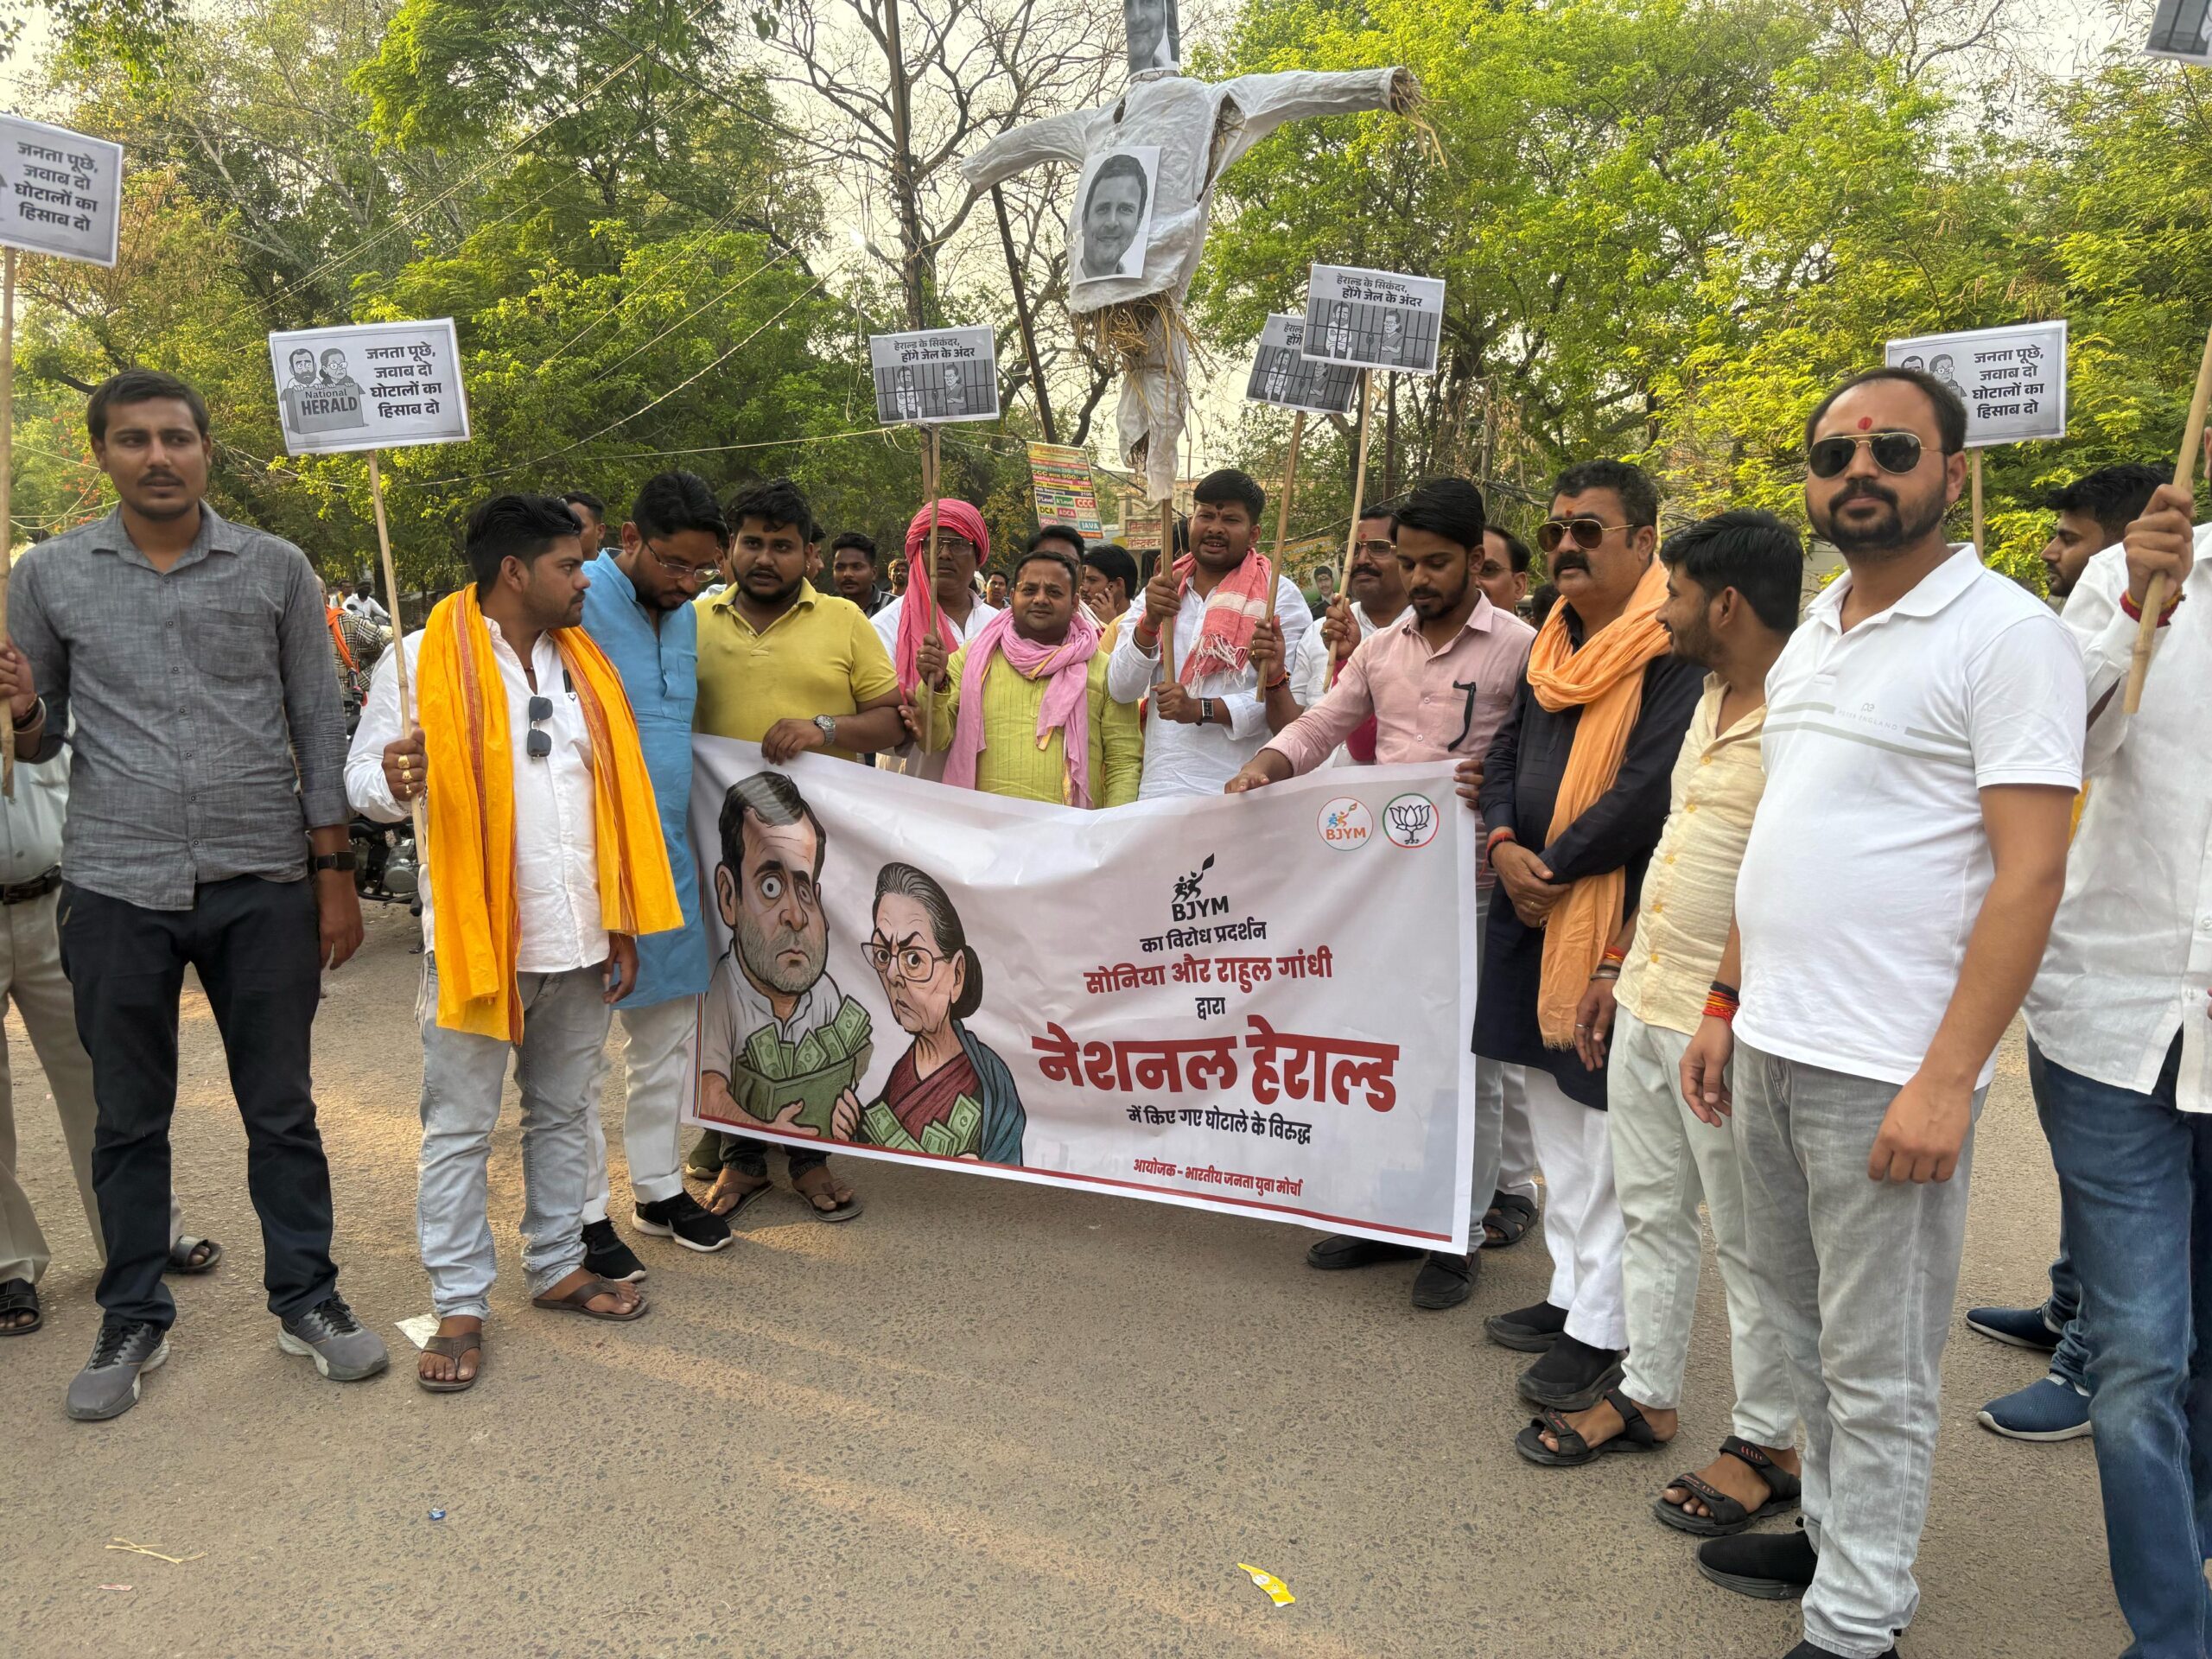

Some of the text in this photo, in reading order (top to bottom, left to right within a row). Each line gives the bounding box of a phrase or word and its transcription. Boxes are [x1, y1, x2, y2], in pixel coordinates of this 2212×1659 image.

[17, 142, 64, 163] जनता
[23, 164, 91, 190] जवाब दो
[14, 181, 99, 212] घोटालों का
[19, 202, 91, 232] हिसाब दो
[1337, 273, 1363, 287] हेराल्ड
[1363, 276, 1374, 288] के
[1342, 285, 1423, 308] होंगे जेल के अंदर
[365, 346, 405, 359] जनता
[893, 340, 918, 351] हेराल्ड
[919, 339, 928, 347] के
[901, 346, 975, 362] होंगे जेल के अंदर
[1974, 350, 2014, 364] जनता
[374, 361, 433, 378] जवाब दो
[1980, 362, 2038, 381] जवाब दो
[305, 389, 346, 398] National
[370, 381, 442, 398] घोटालों का
[1972, 382, 2044, 400] घोटालों का
[302, 397, 357, 415] HERALD
[378, 398, 440, 418] हिसाब दो
[1977, 398, 2039, 419] हिसाब दो
[1859, 715, 1898, 731] ENGLAND
[1325, 827, 1366, 841] BJYM
[1171, 895, 1230, 922] BJYM
[1140, 916, 1268, 953] का विरोध प्रदर्शन
[1084, 944, 1333, 994] सोनिया और राहुल गांधी
[1195, 996, 1225, 1020] द्वारा
[1031, 1014, 1400, 1113] नेशनल हेराल्ड
[1126, 1104, 1313, 1146] में किए गए घोटाले के विरुद्ध
[1134, 1157, 1177, 1179] आयोजक
[1184, 1164, 1223, 1185] भारतीय
[1224, 1173, 1255, 1190] जनता
[1255, 1177, 1275, 1197] युवा
[1276, 1178, 1304, 1197] मोर्चा
